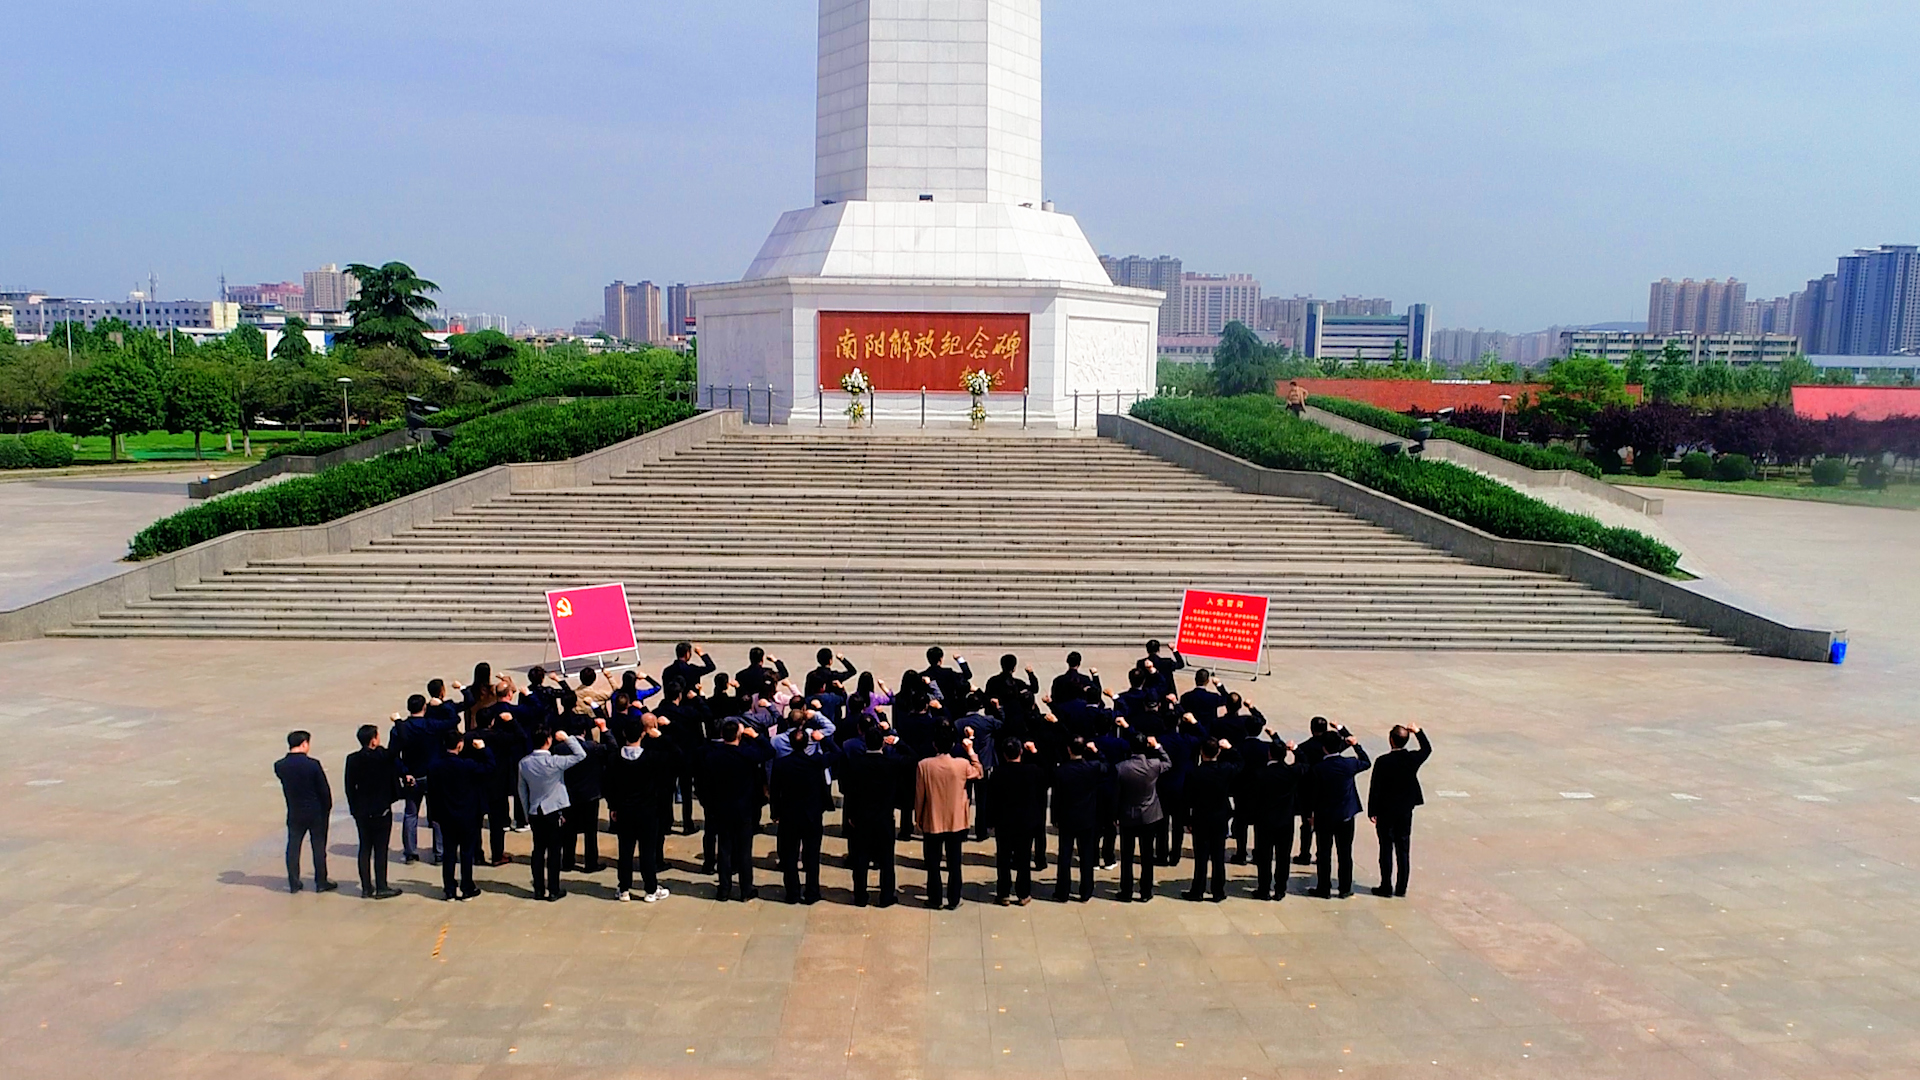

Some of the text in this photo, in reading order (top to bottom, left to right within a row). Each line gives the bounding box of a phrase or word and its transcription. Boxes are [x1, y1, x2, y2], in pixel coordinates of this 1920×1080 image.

[836, 325, 1022, 371] 南阳解放纪念碑
